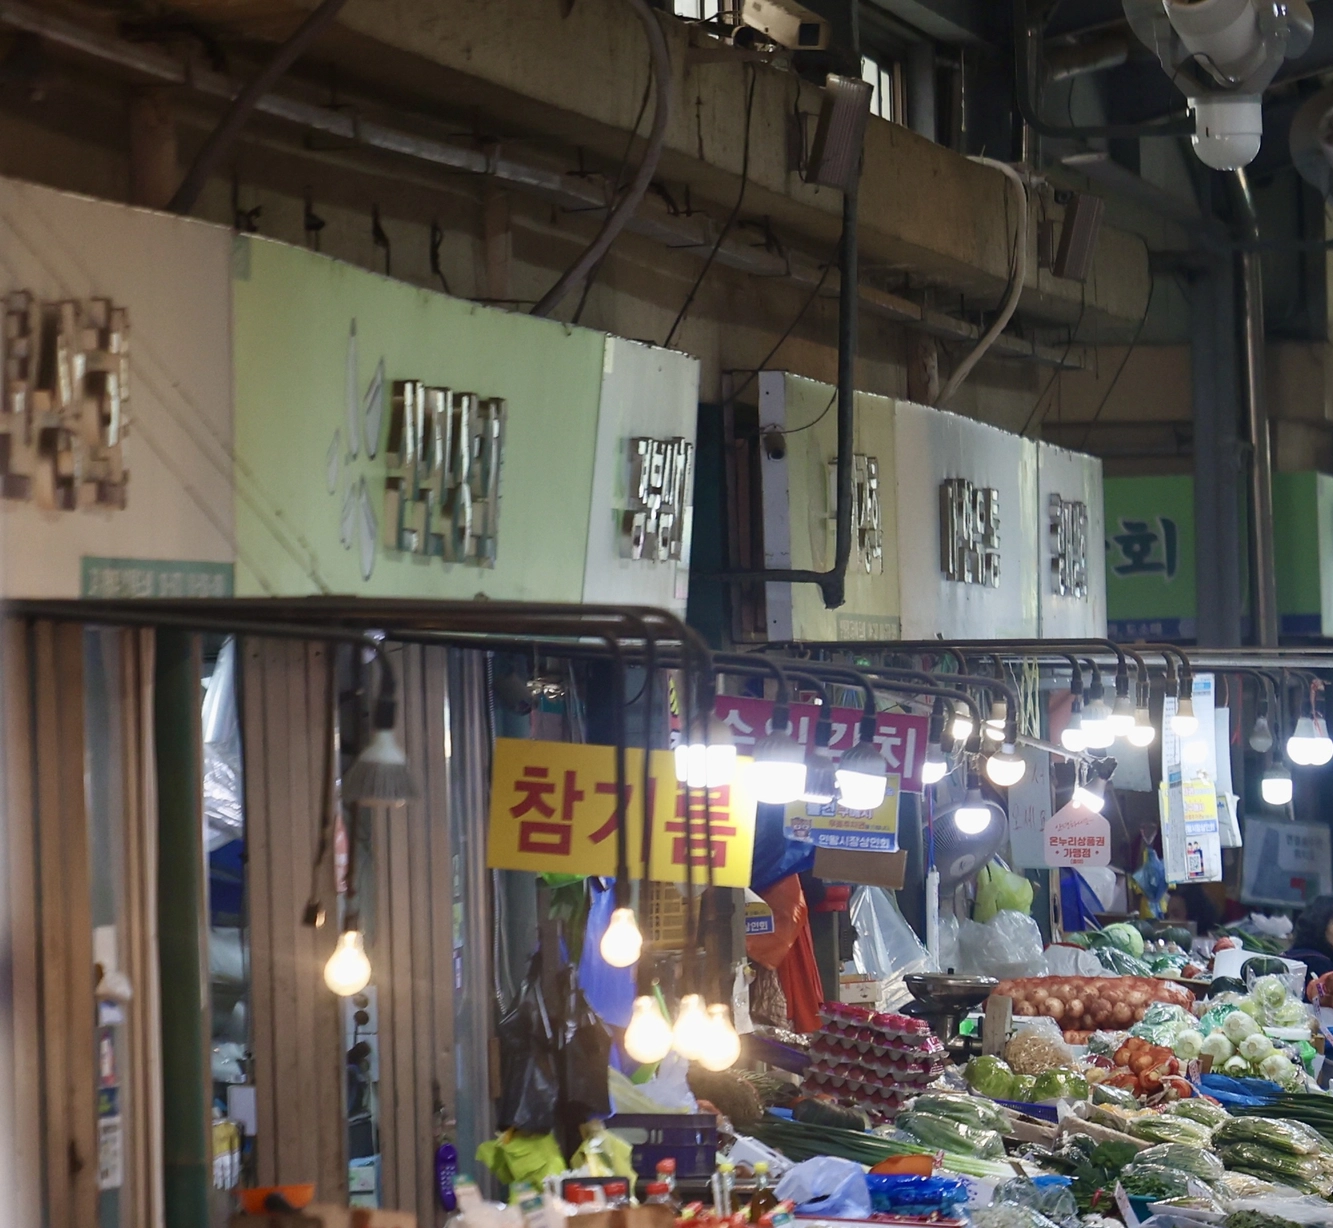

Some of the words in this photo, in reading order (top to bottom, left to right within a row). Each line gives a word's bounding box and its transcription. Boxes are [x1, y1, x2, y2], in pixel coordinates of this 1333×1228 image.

[509, 766, 737, 869] 참기름
[1049, 836, 1106, 847] 온누리상품권
[1063, 848, 1092, 858] 가맹점
